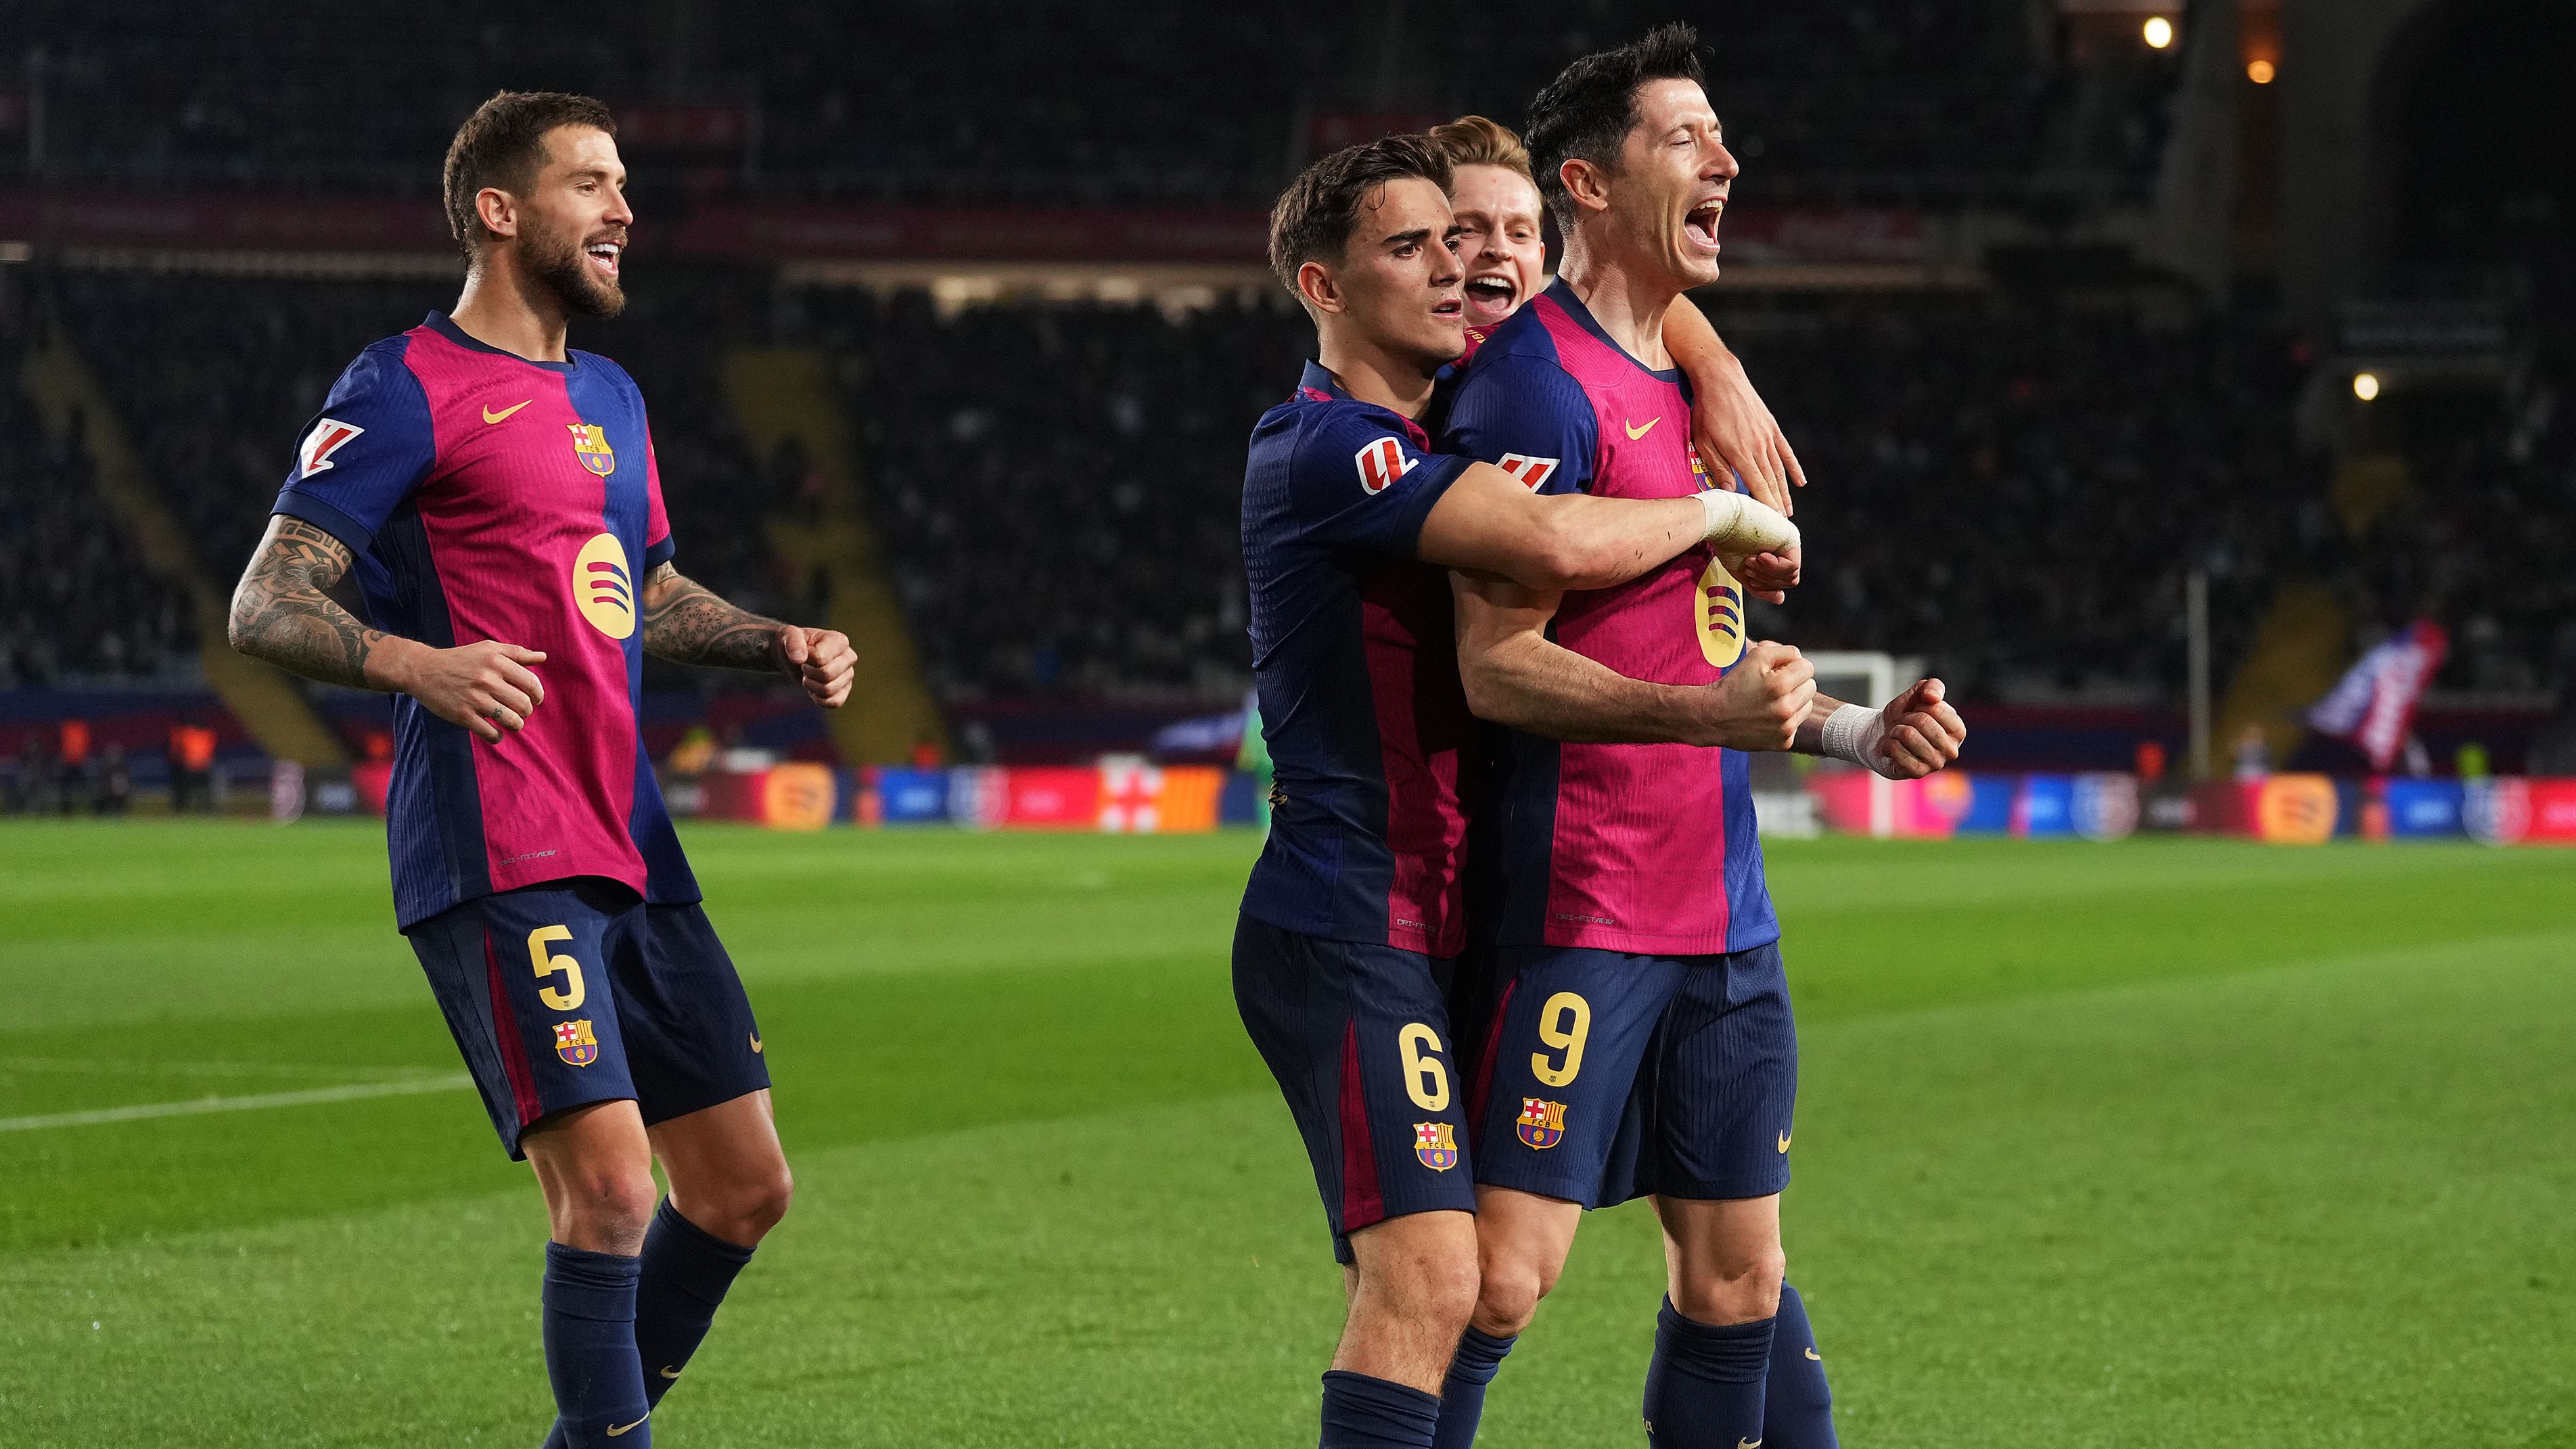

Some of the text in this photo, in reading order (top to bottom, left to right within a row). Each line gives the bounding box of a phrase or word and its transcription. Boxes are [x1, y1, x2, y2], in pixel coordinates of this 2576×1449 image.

[528, 924, 586, 1011] 5
[569, 1038, 586, 1046] FCB
[1398, 1022, 1450, 1111] 6
[1531, 992, 1590, 1087] 9
[1532, 1119, 1550, 1128] FCB
